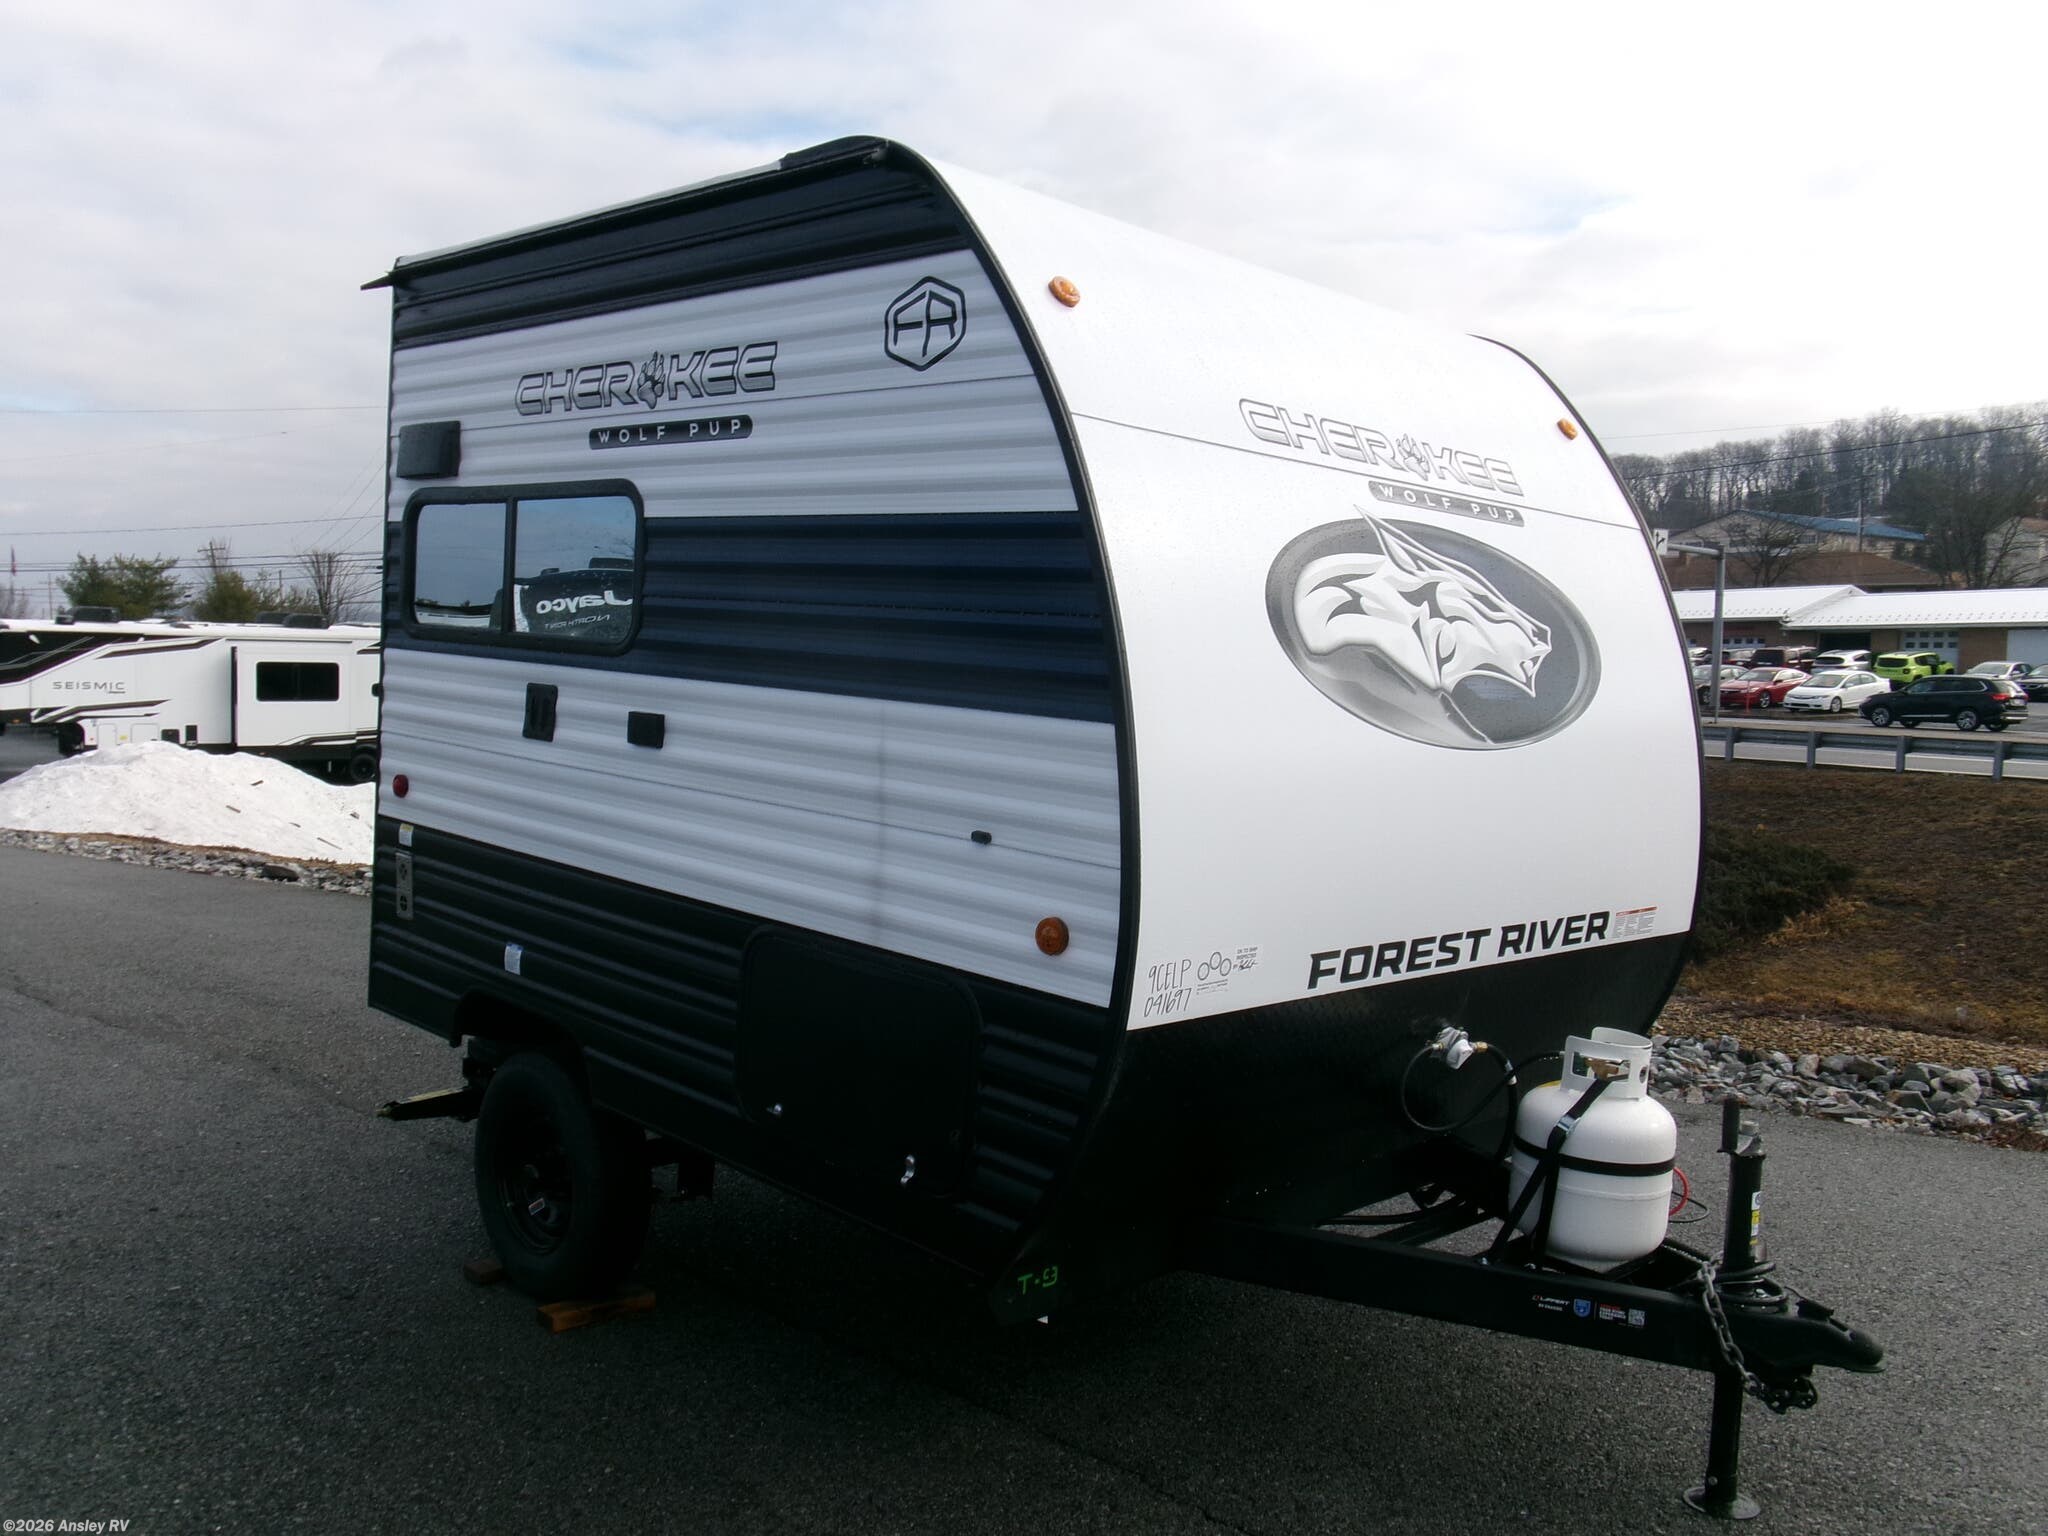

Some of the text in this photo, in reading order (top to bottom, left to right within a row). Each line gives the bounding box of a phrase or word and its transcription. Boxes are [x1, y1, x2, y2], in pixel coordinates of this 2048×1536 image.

[598, 418, 741, 444] WOLF PUP
[1379, 484, 1516, 522] WOLF PUP
[52, 681, 125, 691] SEISMIC
[1307, 928, 1492, 990] FOREST
[1498, 910, 1611, 958] RIVER
